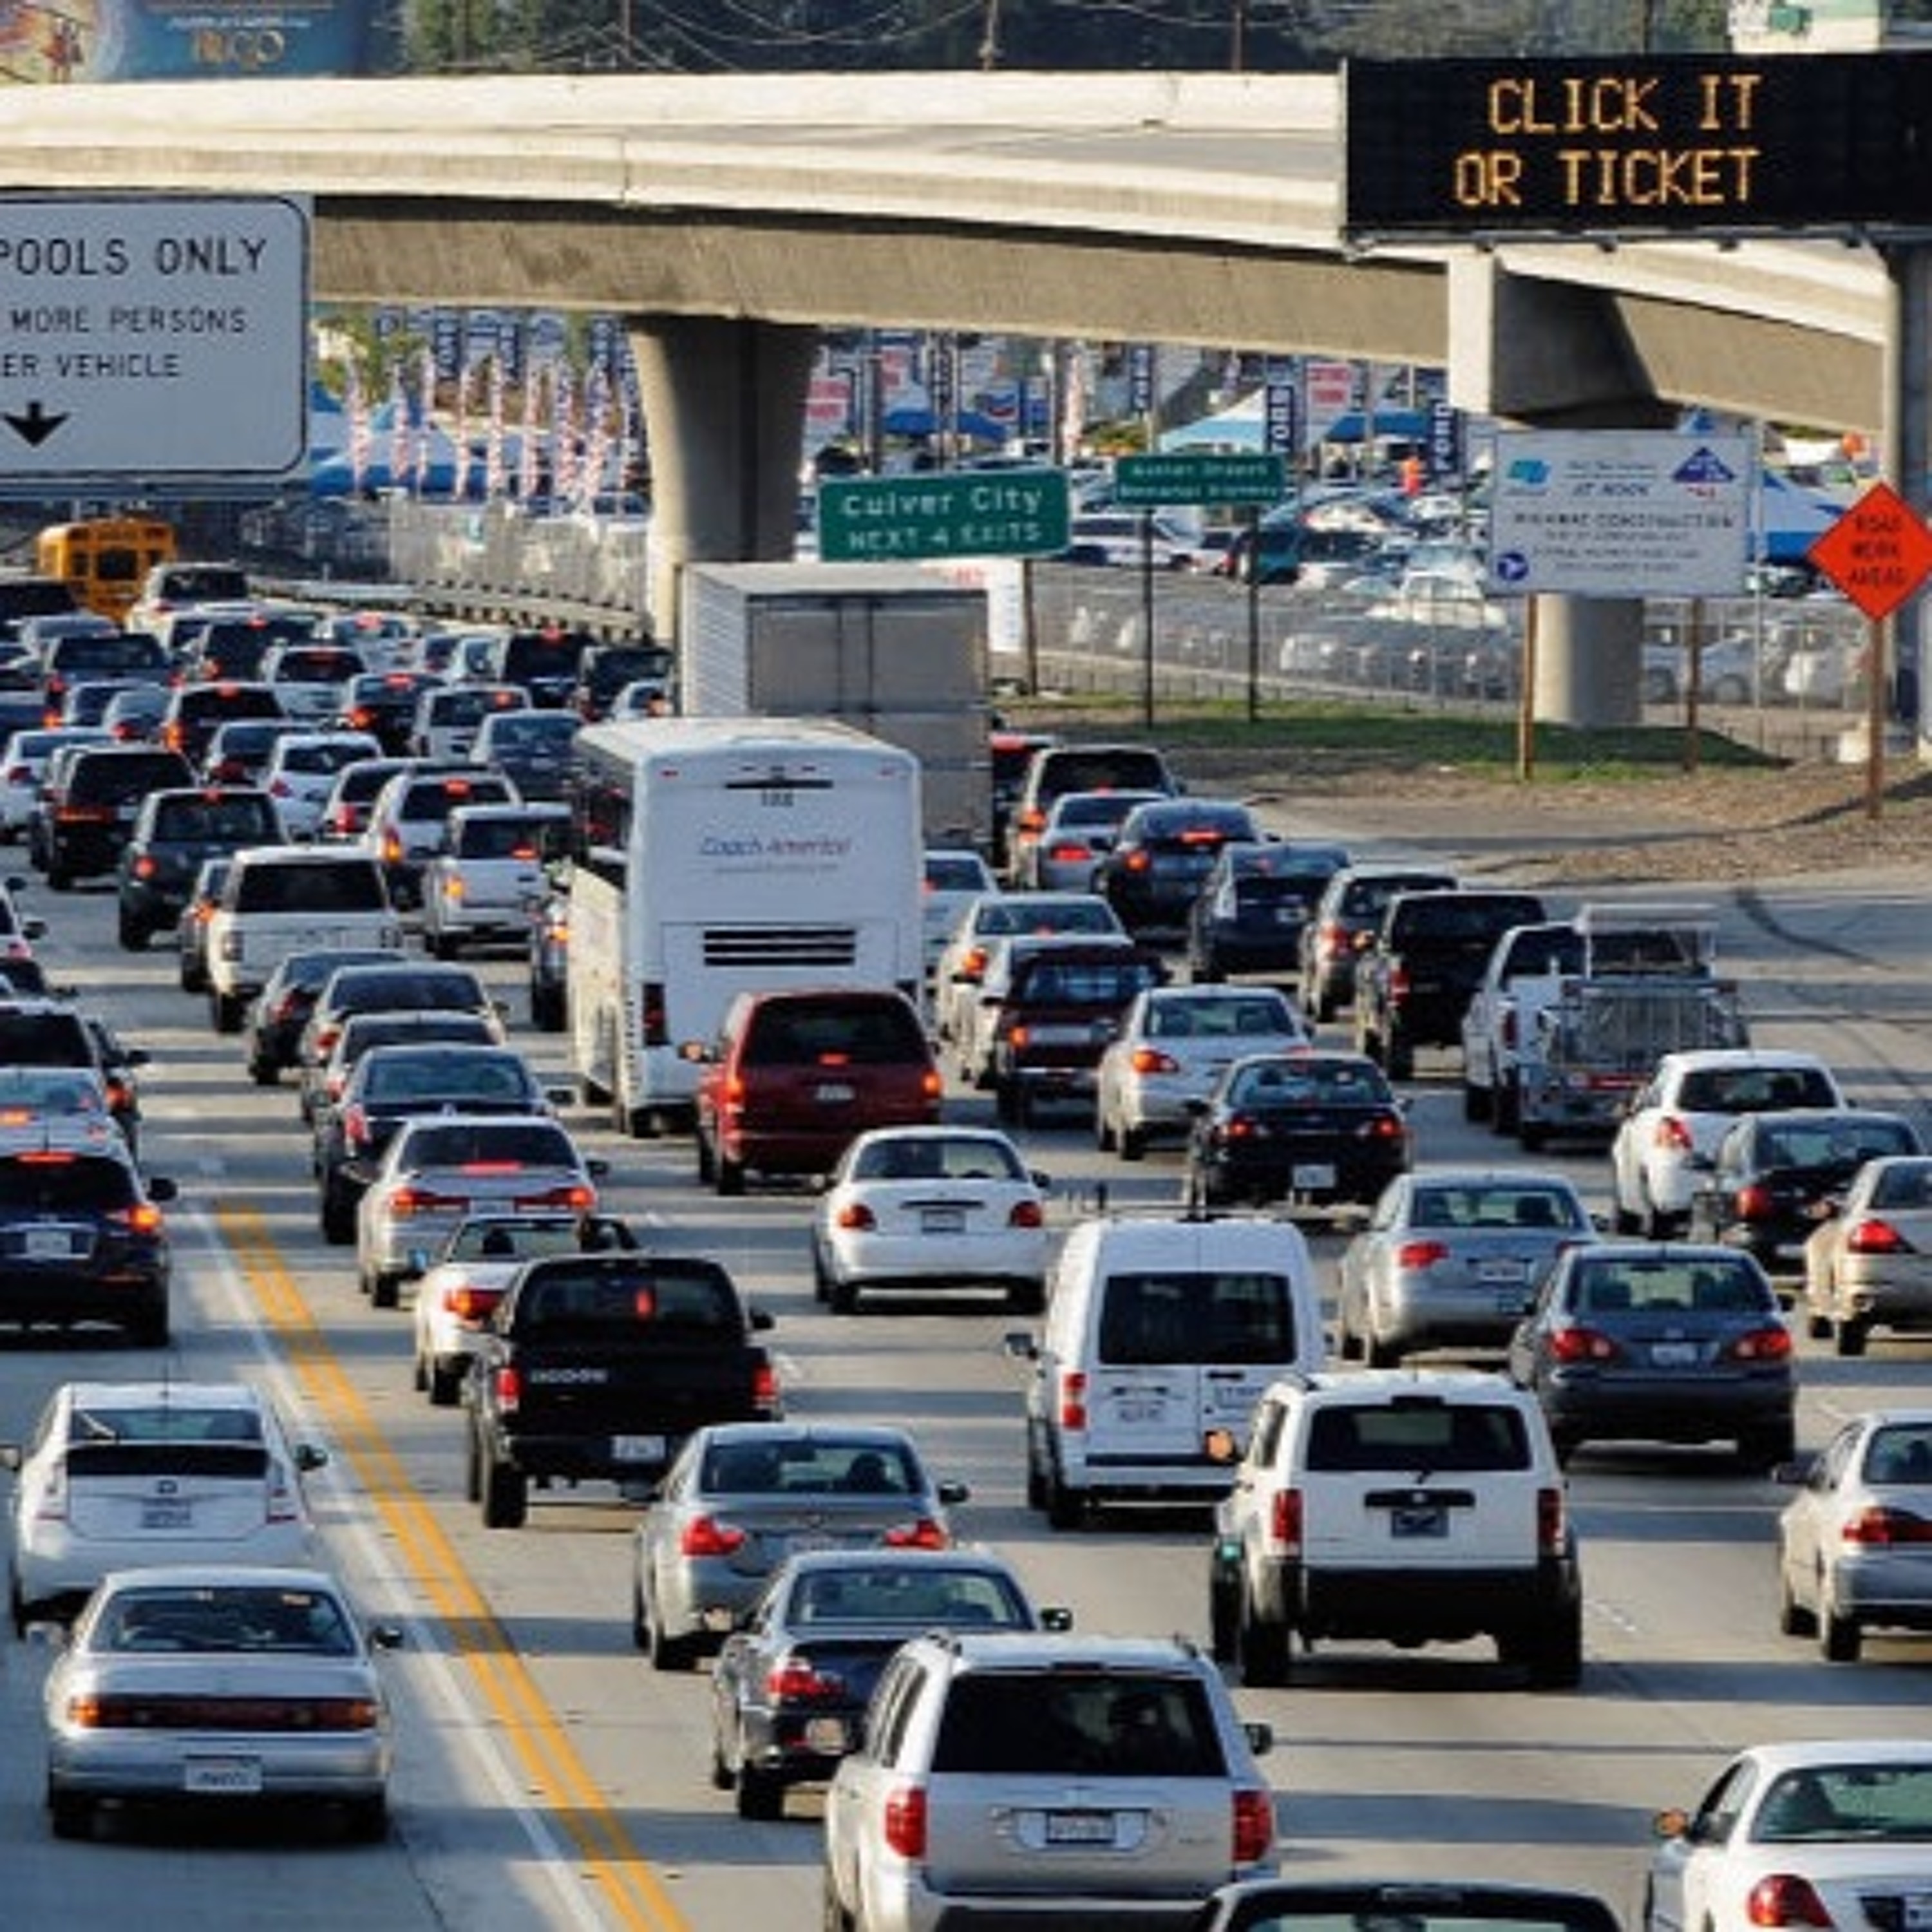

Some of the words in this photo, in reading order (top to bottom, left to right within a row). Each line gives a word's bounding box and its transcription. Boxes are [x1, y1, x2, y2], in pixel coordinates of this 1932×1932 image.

[1488, 78, 1660, 133] CLICK
[1700, 74, 1762, 130] IT
[1454, 152, 1522, 207] OR
[1558, 149, 1762, 206] TICKET
[156, 237, 267, 276] ONLY
[11, 308, 90, 333] MORE
[110, 308, 247, 334] PERSONS
[57, 354, 182, 377] VEHICLE
[842, 494, 953, 516] Culver
[971, 486, 1041, 515] City
[848, 527, 920, 550] NEXT
